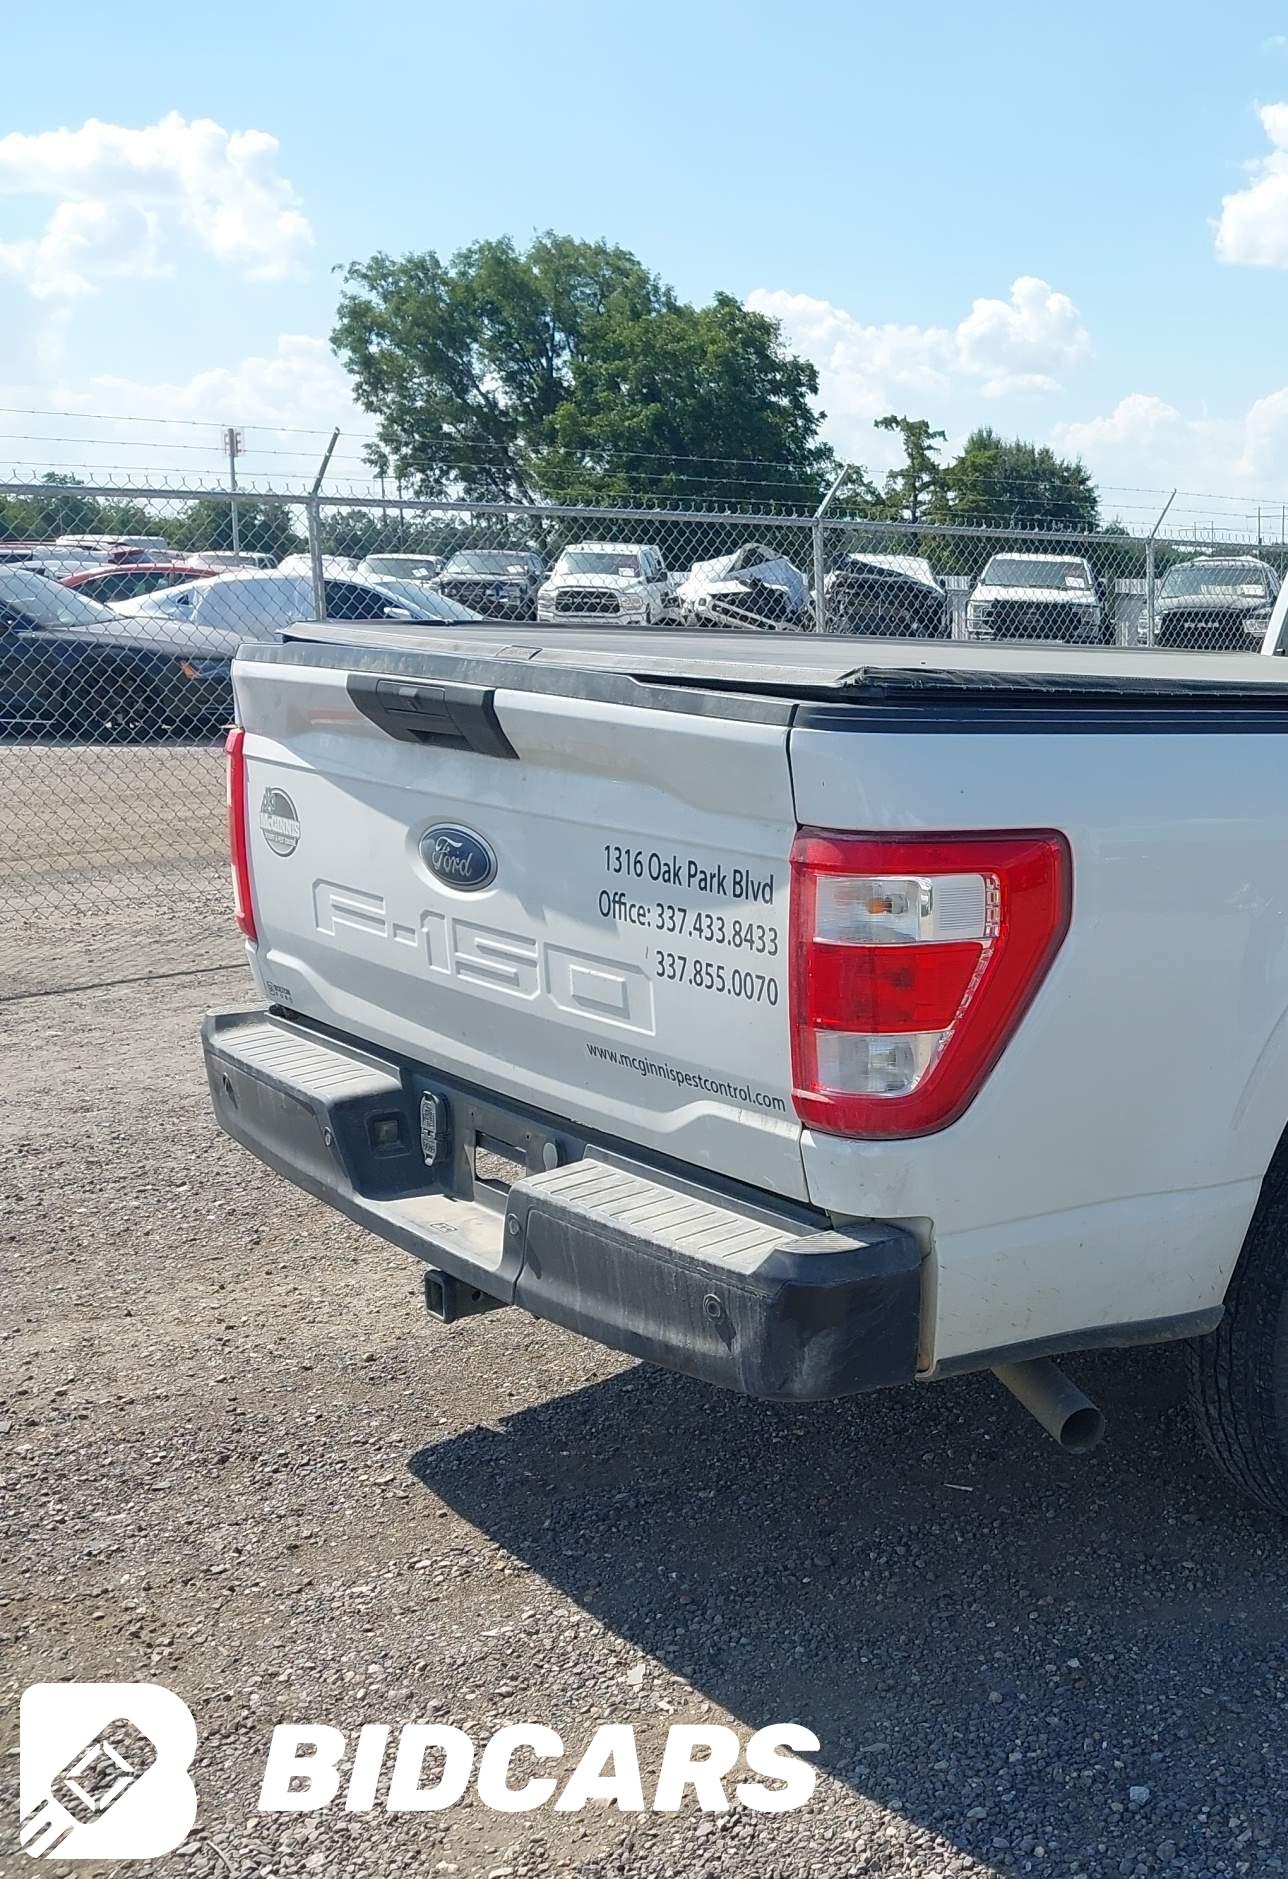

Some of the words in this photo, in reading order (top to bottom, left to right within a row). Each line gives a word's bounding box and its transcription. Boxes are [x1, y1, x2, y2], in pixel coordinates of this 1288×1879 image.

[431, 836, 473, 877] Ford
[604, 845, 644, 878] 1316
[648, 852, 683, 886] Oak
[687, 860, 728, 897] Park
[732, 868, 775, 905] Blvd
[598, 889, 652, 928] Office:
[656, 902, 779, 957] 337.433.8433
[311, 877, 656, 1038] F-150
[656, 950, 779, 1006] 337.855.0070
[586, 1043, 787, 1112] www.mcginnispestcontrol.com
